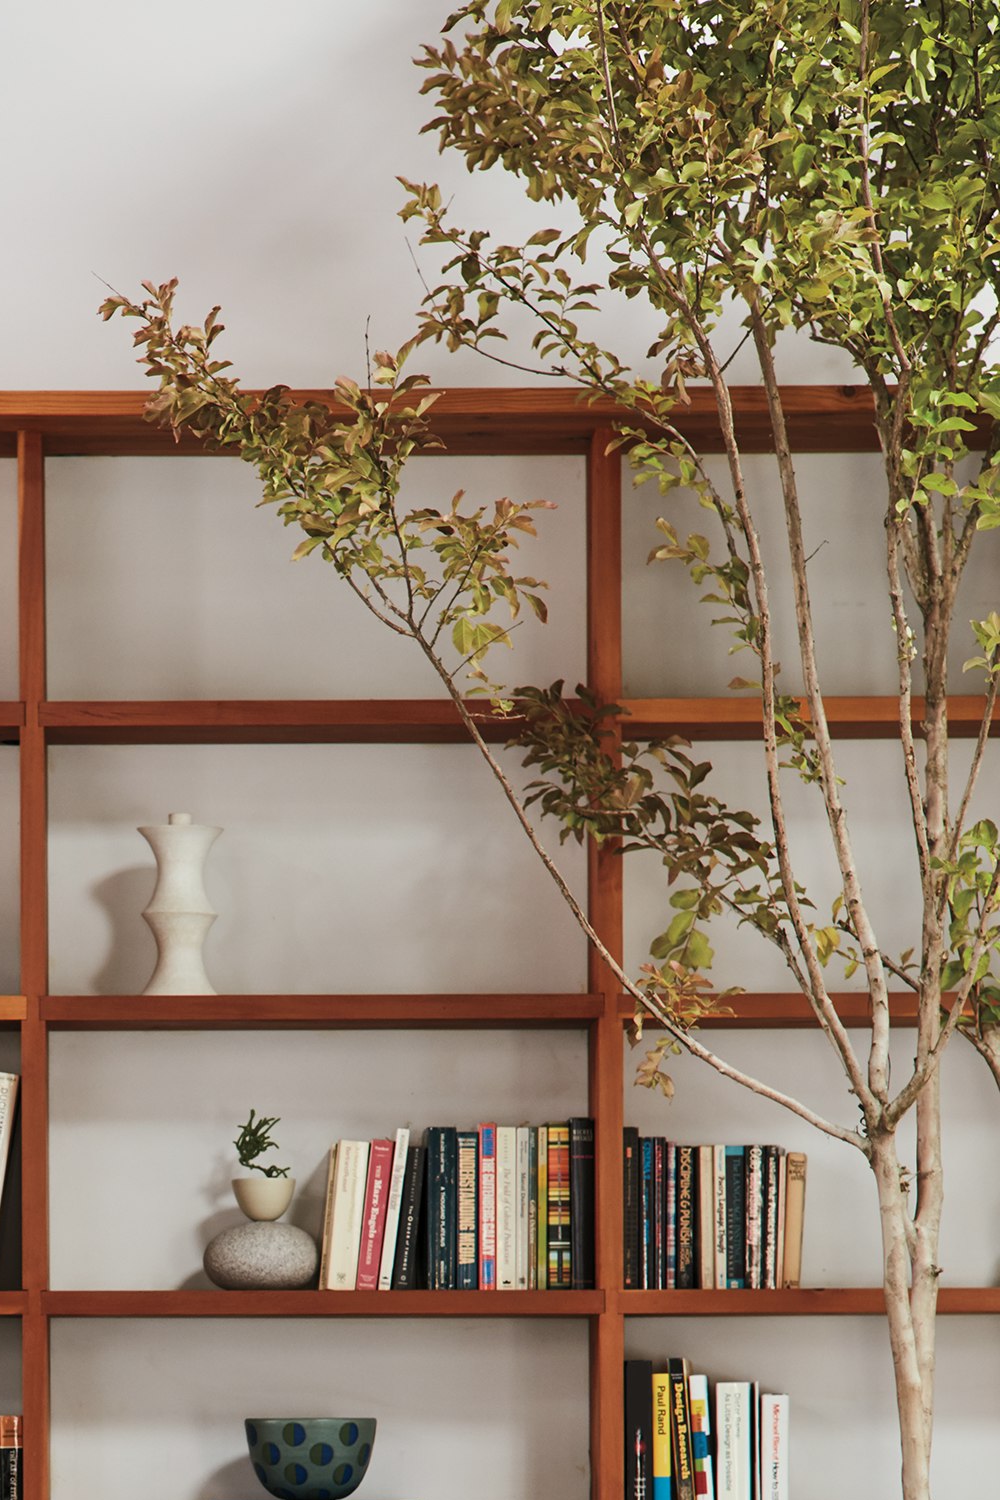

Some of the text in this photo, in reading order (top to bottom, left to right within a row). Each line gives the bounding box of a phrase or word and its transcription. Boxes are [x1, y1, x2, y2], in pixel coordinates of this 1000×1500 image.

[459, 1148, 475, 1264] UNDERSTANDING MEDIA
[656, 1385, 667, 1436] Paul Rand
[724, 1393, 732, 1402] As
[725, 1403, 733, 1422] Little
[673, 1382, 691, 1480] Design Research
[723, 1424, 733, 1450] Design
[725, 1451, 732, 1460] as
[772, 1404, 780, 1491] Michael Bierut How to
[725, 1461, 733, 1492] Possible
